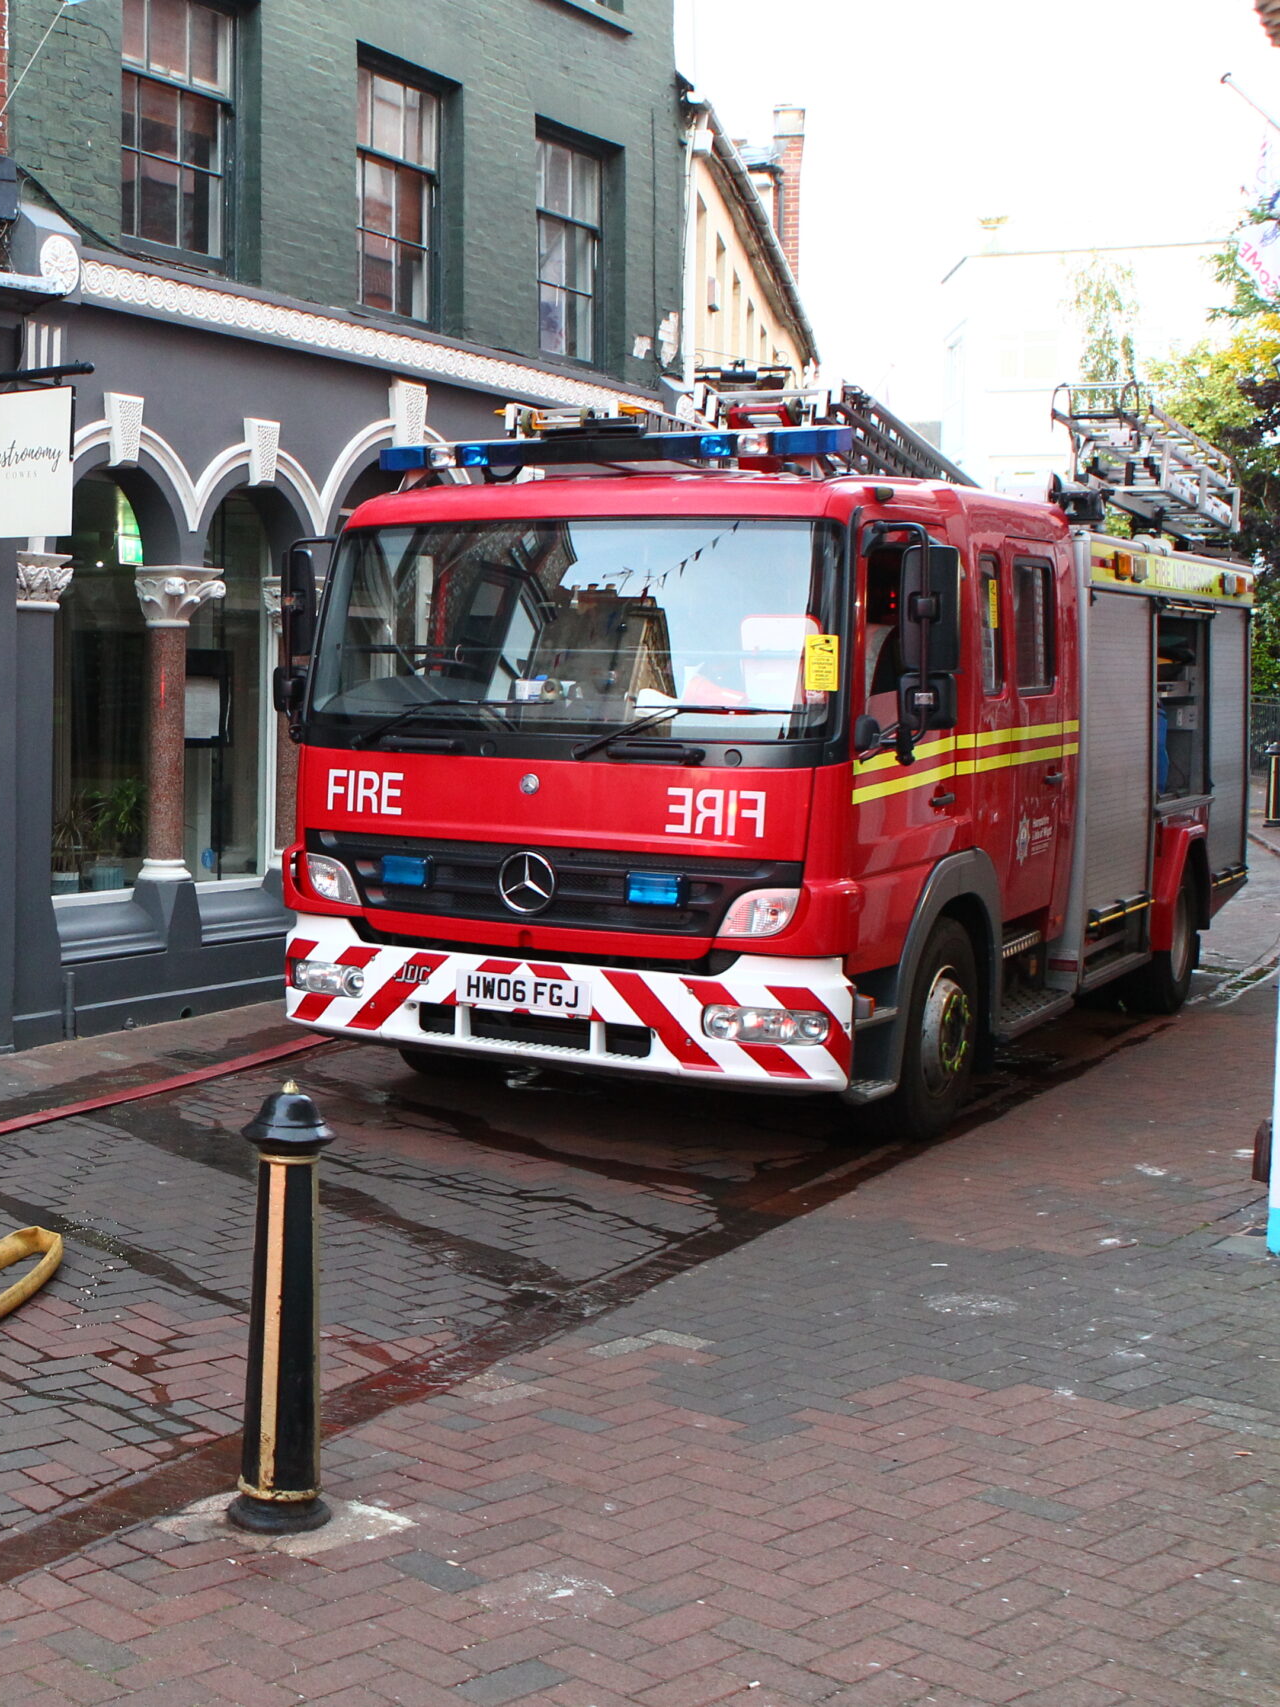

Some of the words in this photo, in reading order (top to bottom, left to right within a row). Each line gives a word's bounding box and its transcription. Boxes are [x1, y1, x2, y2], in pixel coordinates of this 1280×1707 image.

[5, 471, 38, 479] COWES
[326, 768, 404, 815] FIRE
[467, 975, 526, 1003] HW06
[533, 982, 578, 1008] FGJ
